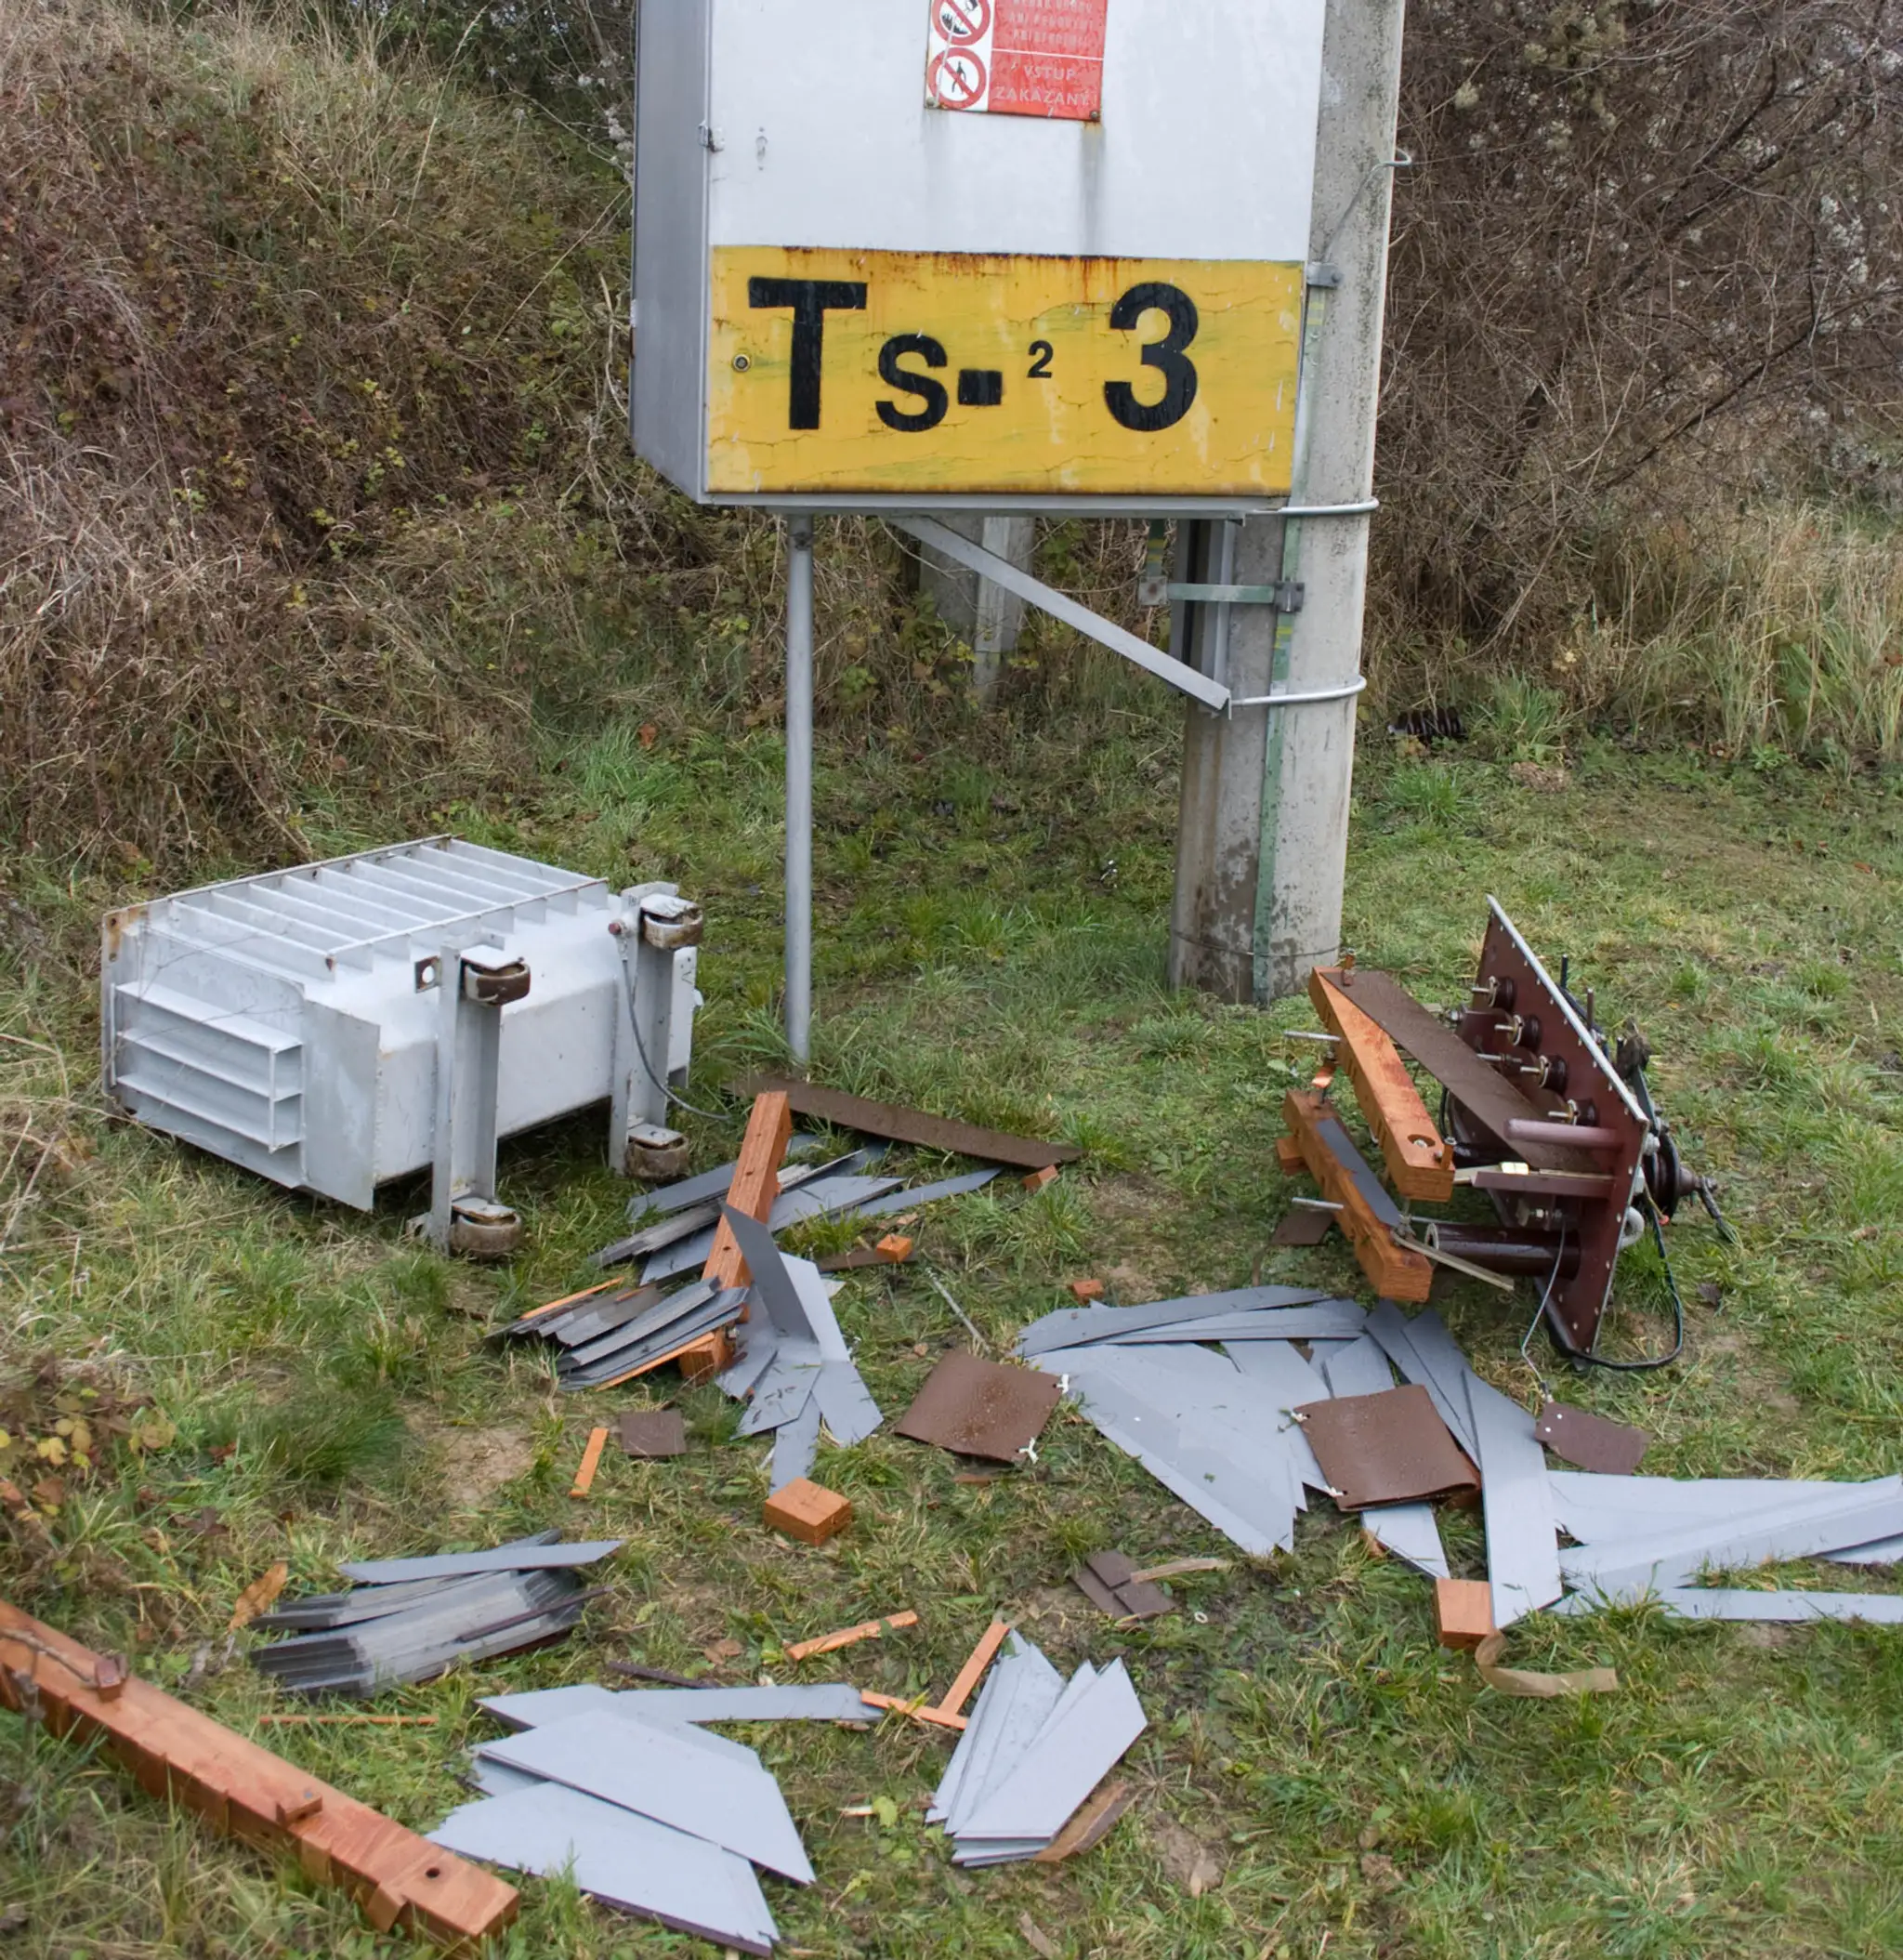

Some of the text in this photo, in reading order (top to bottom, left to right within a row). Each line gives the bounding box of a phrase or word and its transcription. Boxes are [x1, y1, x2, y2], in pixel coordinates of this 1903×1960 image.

[1024, 65, 1076, 81] VSTUP
[1027, 340, 1054, 378] 2
[1104, 282, 1199, 432] 3
